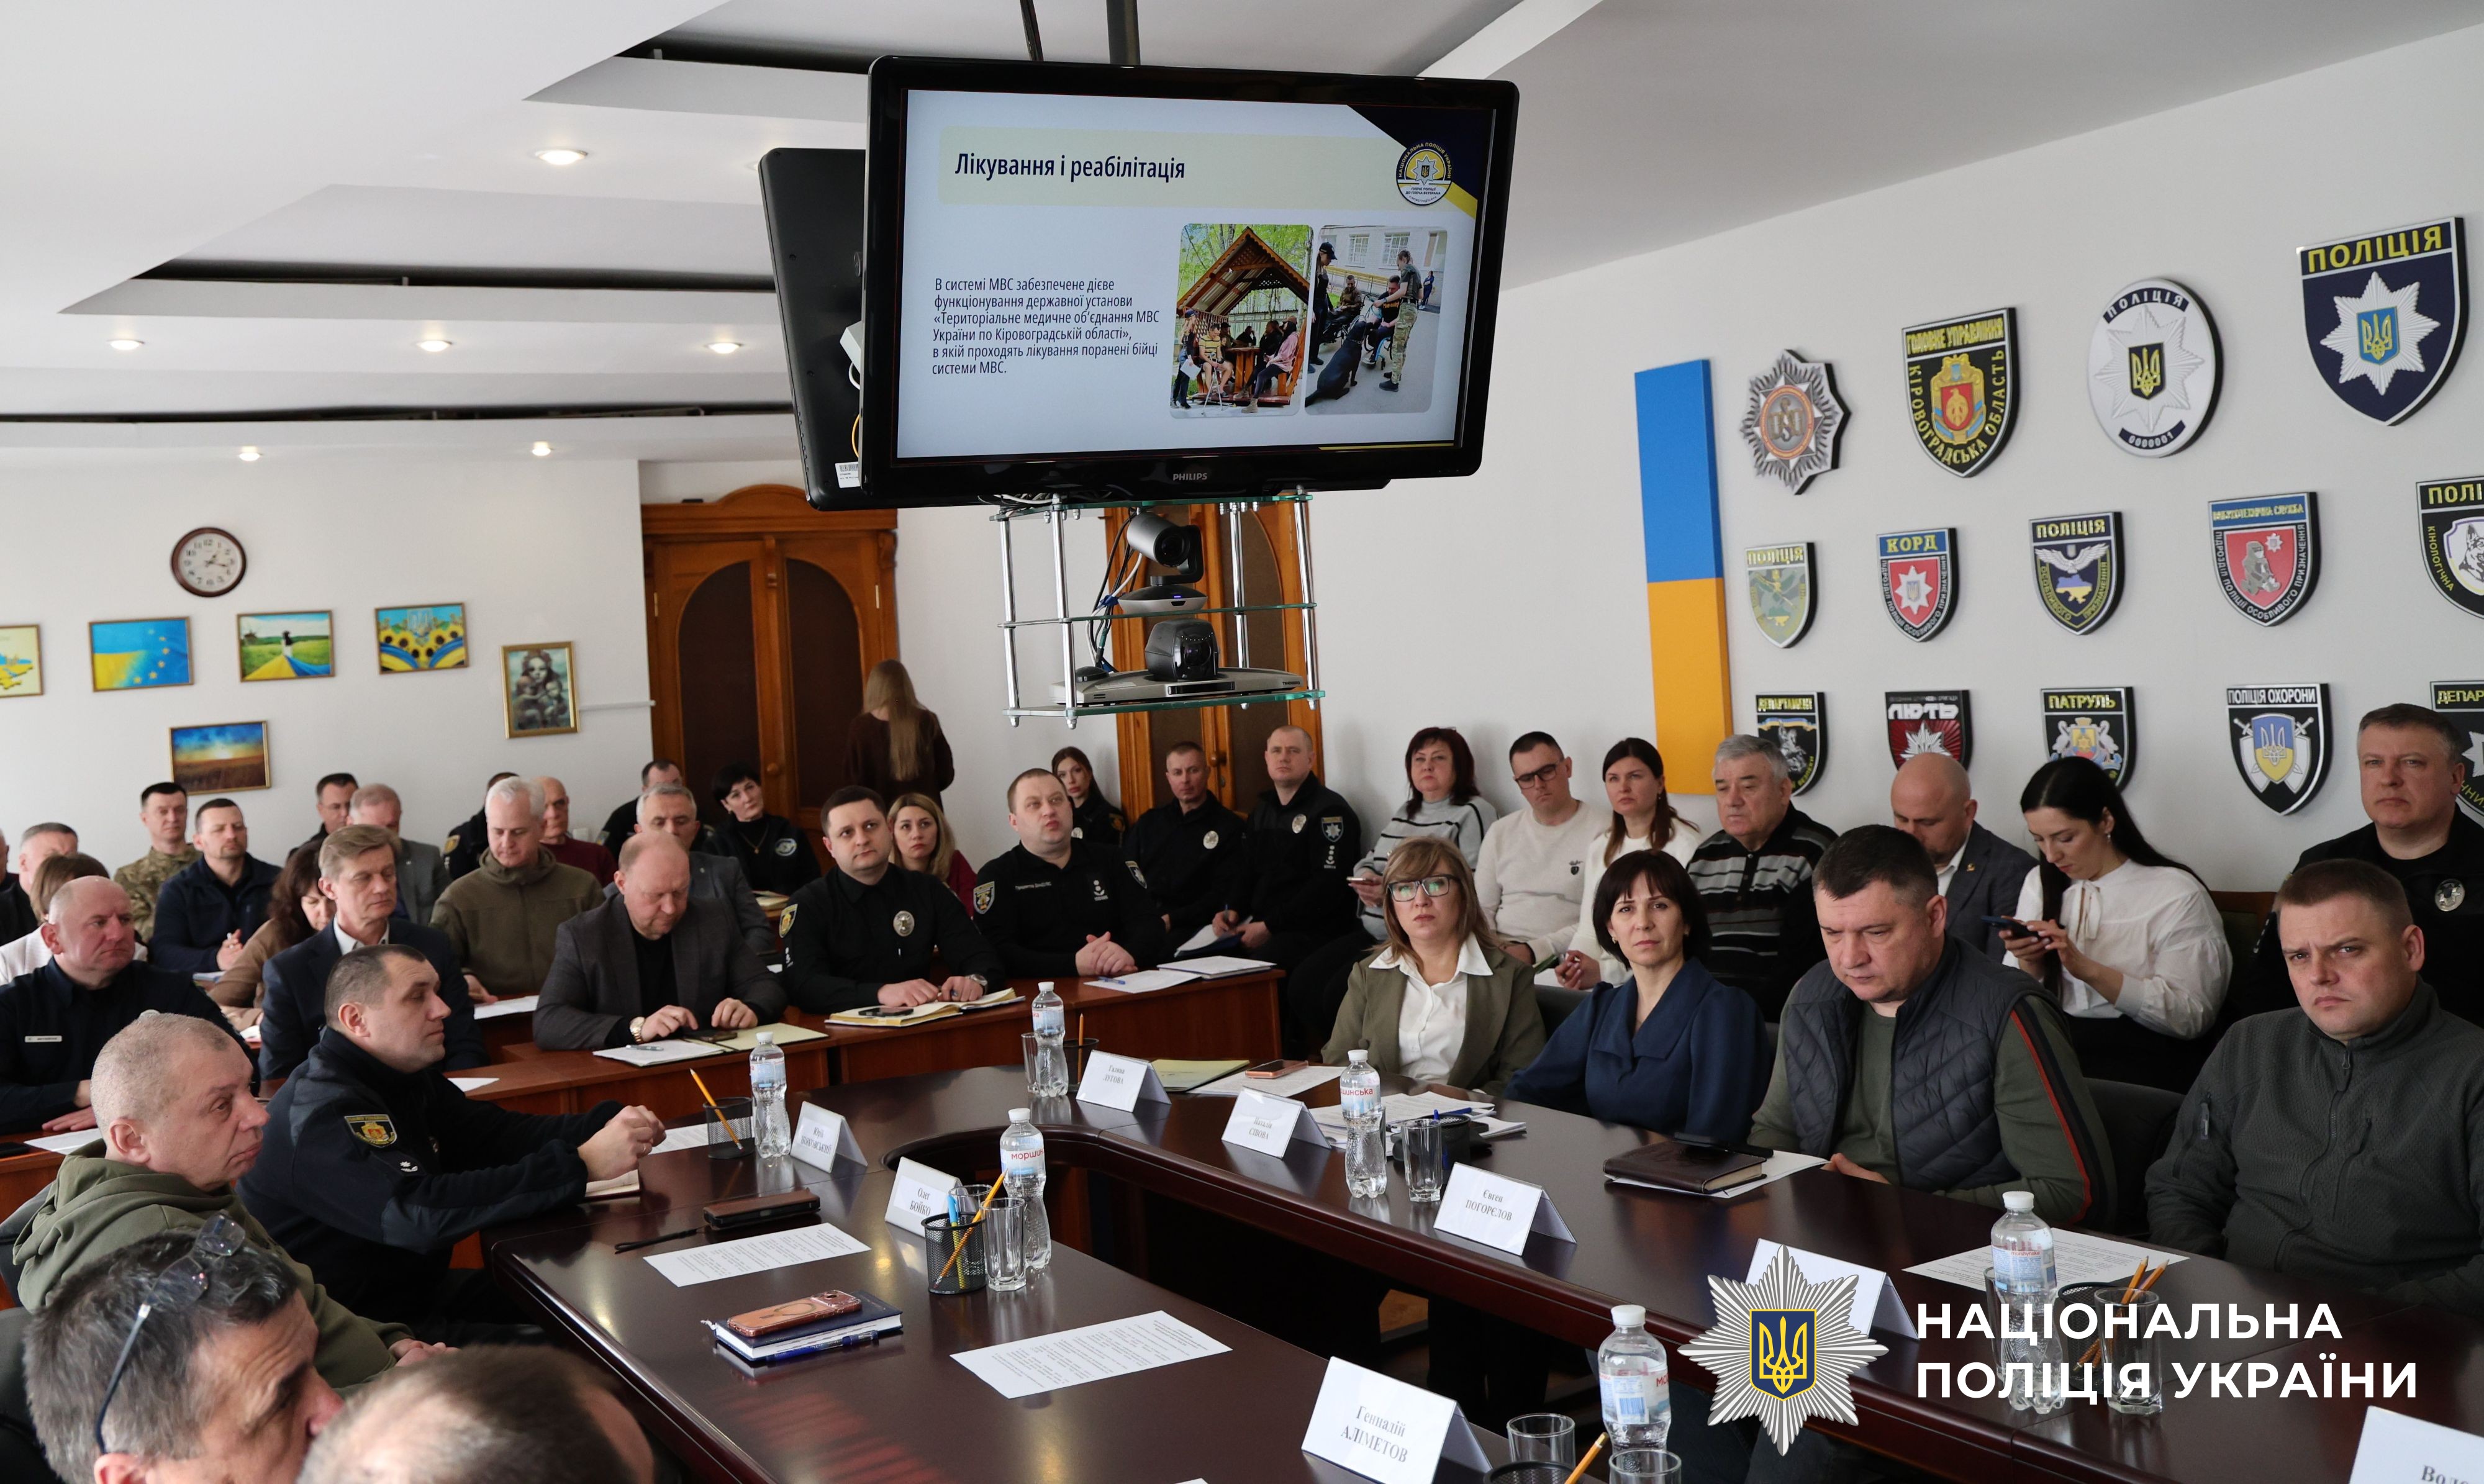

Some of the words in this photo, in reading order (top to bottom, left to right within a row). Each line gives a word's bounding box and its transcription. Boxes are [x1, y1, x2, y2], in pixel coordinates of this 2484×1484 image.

[1425, 142, 1445, 155] ПОЛІЦІЯ
[955, 153, 1054, 181] Лікування
[1060, 155, 1066, 176] і
[1071, 155, 1185, 183] реабілітація
[2308, 226, 2442, 273] ПОЛІЦІЯ
[935, 279, 941, 290] В
[945, 278, 986, 291] системі
[989, 278, 1013, 291] МВС
[1017, 278, 1085, 291] забезпечене
[1087, 278, 1115, 292] дієве
[935, 295, 1023, 310] функціонування
[1027, 295, 1084, 310] державної
[1086, 296, 1133, 310] установи
[2108, 291, 2184, 318] ПОЛІЦІЯ
[934, 312, 1021, 327] «Територіальне
[1024, 313, 1071, 325] медичне
[1136, 310, 1159, 323] МВС
[933, 328, 976, 342] України
[979, 330, 992, 341] по
[995, 327, 1082, 343] Кіровоградській
[1085, 327, 1132, 342] області»,
[1906, 328, 1947, 355] ГОЛОВНЕ
[1946, 317, 2004, 348] УПРАВЛІННЯ
[933, 347, 938, 358] в
[941, 345, 964, 358] якій
[968, 346, 1023, 360] проходять
[1027, 344, 1079, 360] лікування
[1082, 343, 1129, 359] поранені
[1132, 342, 1158, 356] бійці
[932, 363, 976, 374] системи
[979, 361, 1007, 374] МВС.
[1909, 364, 1987, 465] КІРОВОГРАДСЬКА
[1985, 350, 2006, 436] ОБЛАСТЬ
[1172, 473, 1208, 481] PHILIPS
[2036, 518, 2106, 538] ПОЛІЦІЯ
[1886, 534, 1938, 553] КОРД
[1747, 546, 1803, 565] ПОЛІЦІЯ
[2427, 526, 2455, 591] КІНОЛОГІЧНА
[2215, 531, 2228, 577] ПІДРОЗДІЛ
[2247, 589, 2298, 620] ОСОБЛИВОГО
[2294, 524, 2306, 587] ПРИЗНАЧЕННЯ
[2049, 695, 2116, 709] ПАТРУЛЬ
[2228, 689, 2267, 705] ПОЛІЦІЯ
[2267, 688, 2316, 704] ОХОРОНИ
[1888, 702, 1959, 720] ЛЮТЬ
[917, 1187, 931, 1200] Олег
[1483, 1189, 1503, 1203] Євген
[910, 1200, 931, 1216] БОЙКО
[1466, 1199, 1513, 1221] ПОГОРЄЛОВ
[1356, 1405, 1406, 1438] Геннадій
[1340, 1425, 1408, 1463] АЛІМЕТОВ
